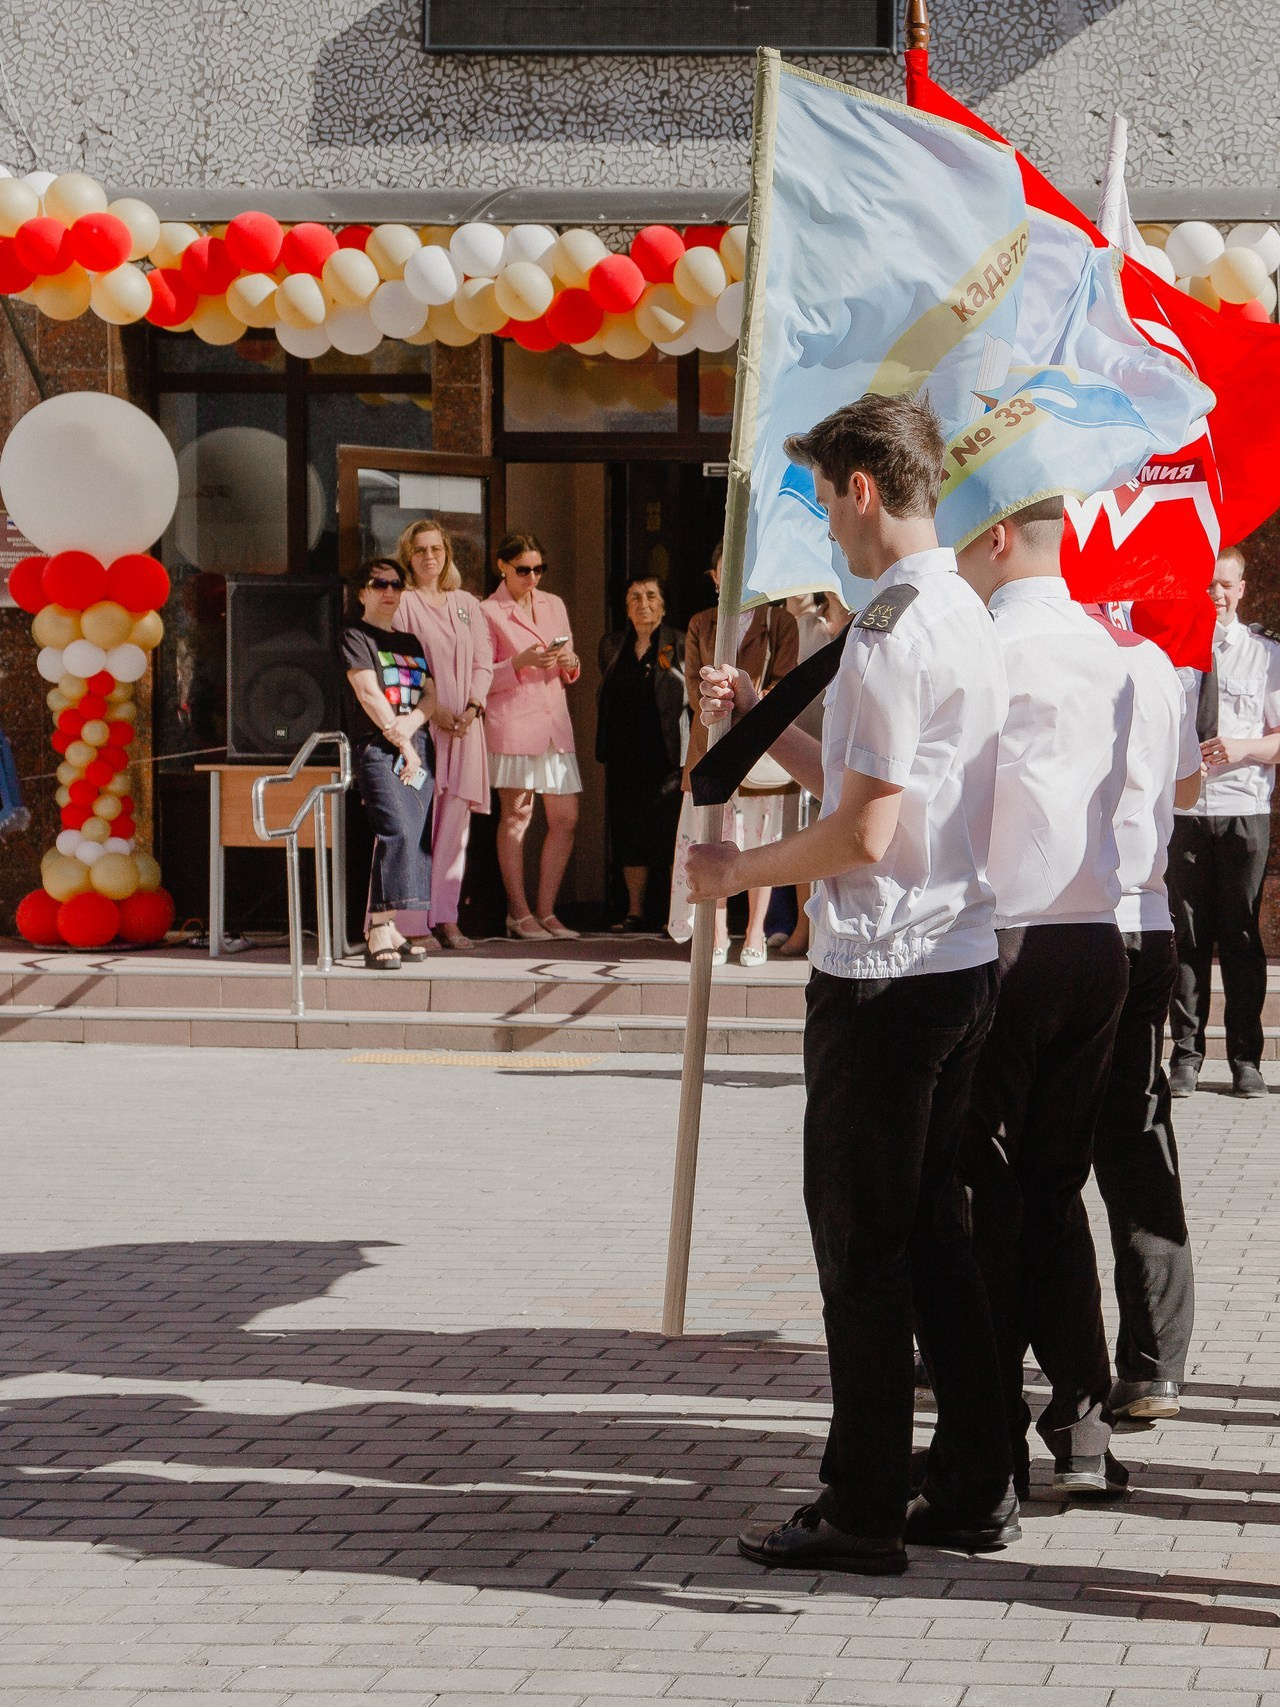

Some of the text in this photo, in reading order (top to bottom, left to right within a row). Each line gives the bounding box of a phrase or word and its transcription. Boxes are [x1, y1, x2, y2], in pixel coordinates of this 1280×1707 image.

[950, 398, 1036, 467] № 33
[862, 613, 891, 628] 33
